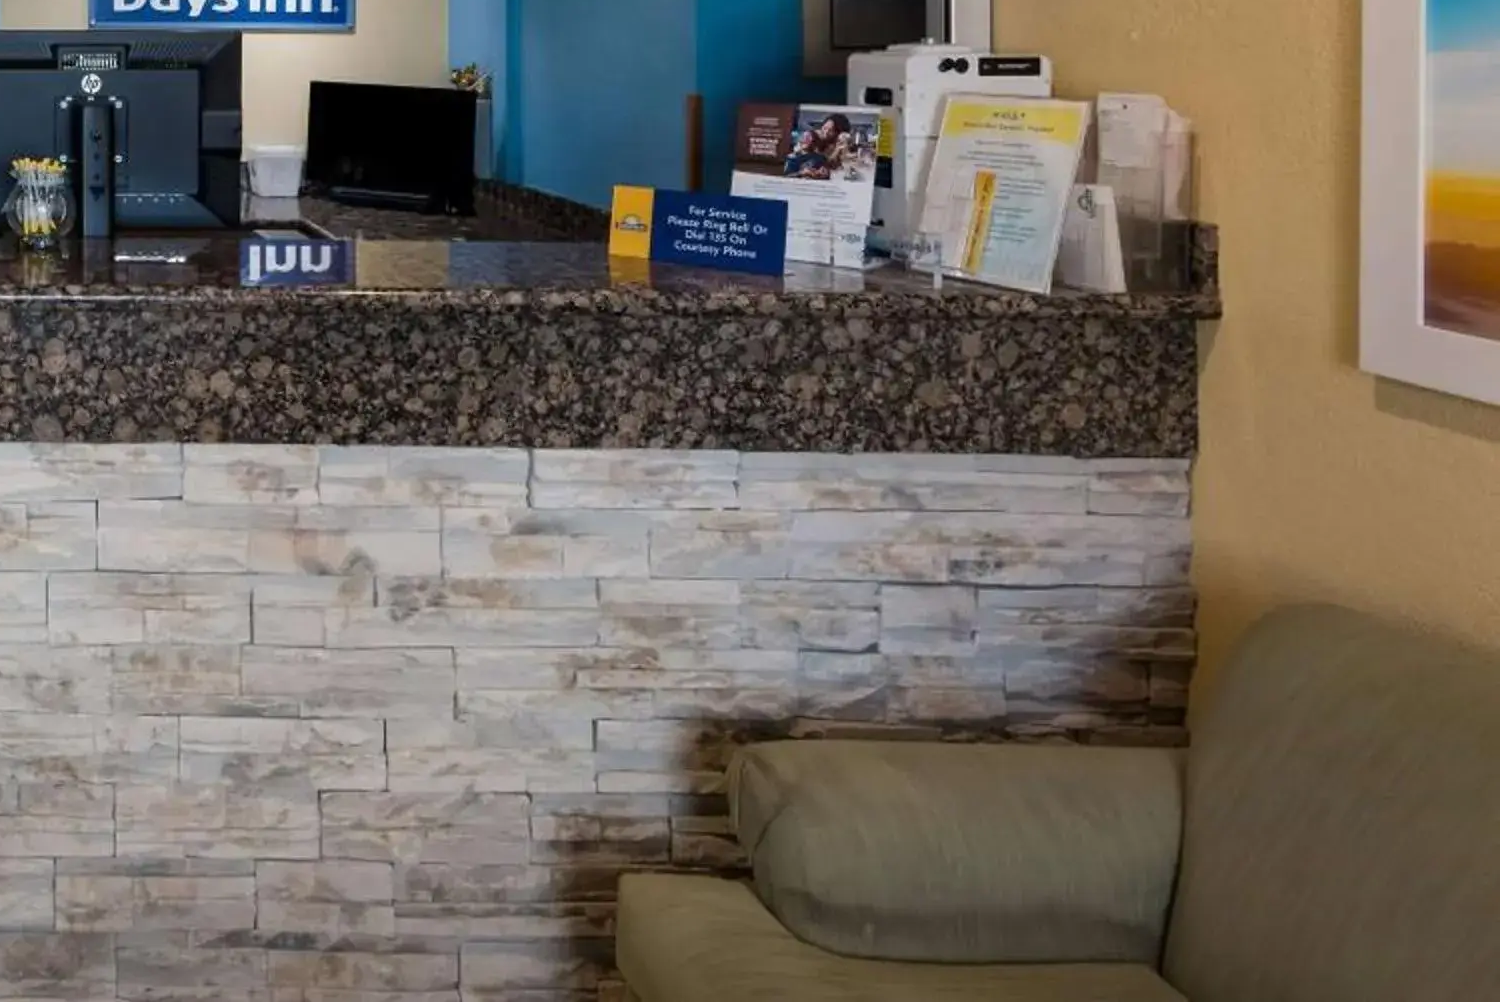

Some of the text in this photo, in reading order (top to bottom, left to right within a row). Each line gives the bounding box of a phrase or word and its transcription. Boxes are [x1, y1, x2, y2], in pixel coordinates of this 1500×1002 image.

[81, 73, 102, 94] hp
[688, 205, 747, 220] For Service
[667, 215, 700, 228] Please
[703, 220, 727, 233] Ring
[752, 224, 768, 236] Or
[685, 229, 705, 241] Dial
[729, 233, 747, 246] On
[673, 239, 757, 259] Courtesy Phone
